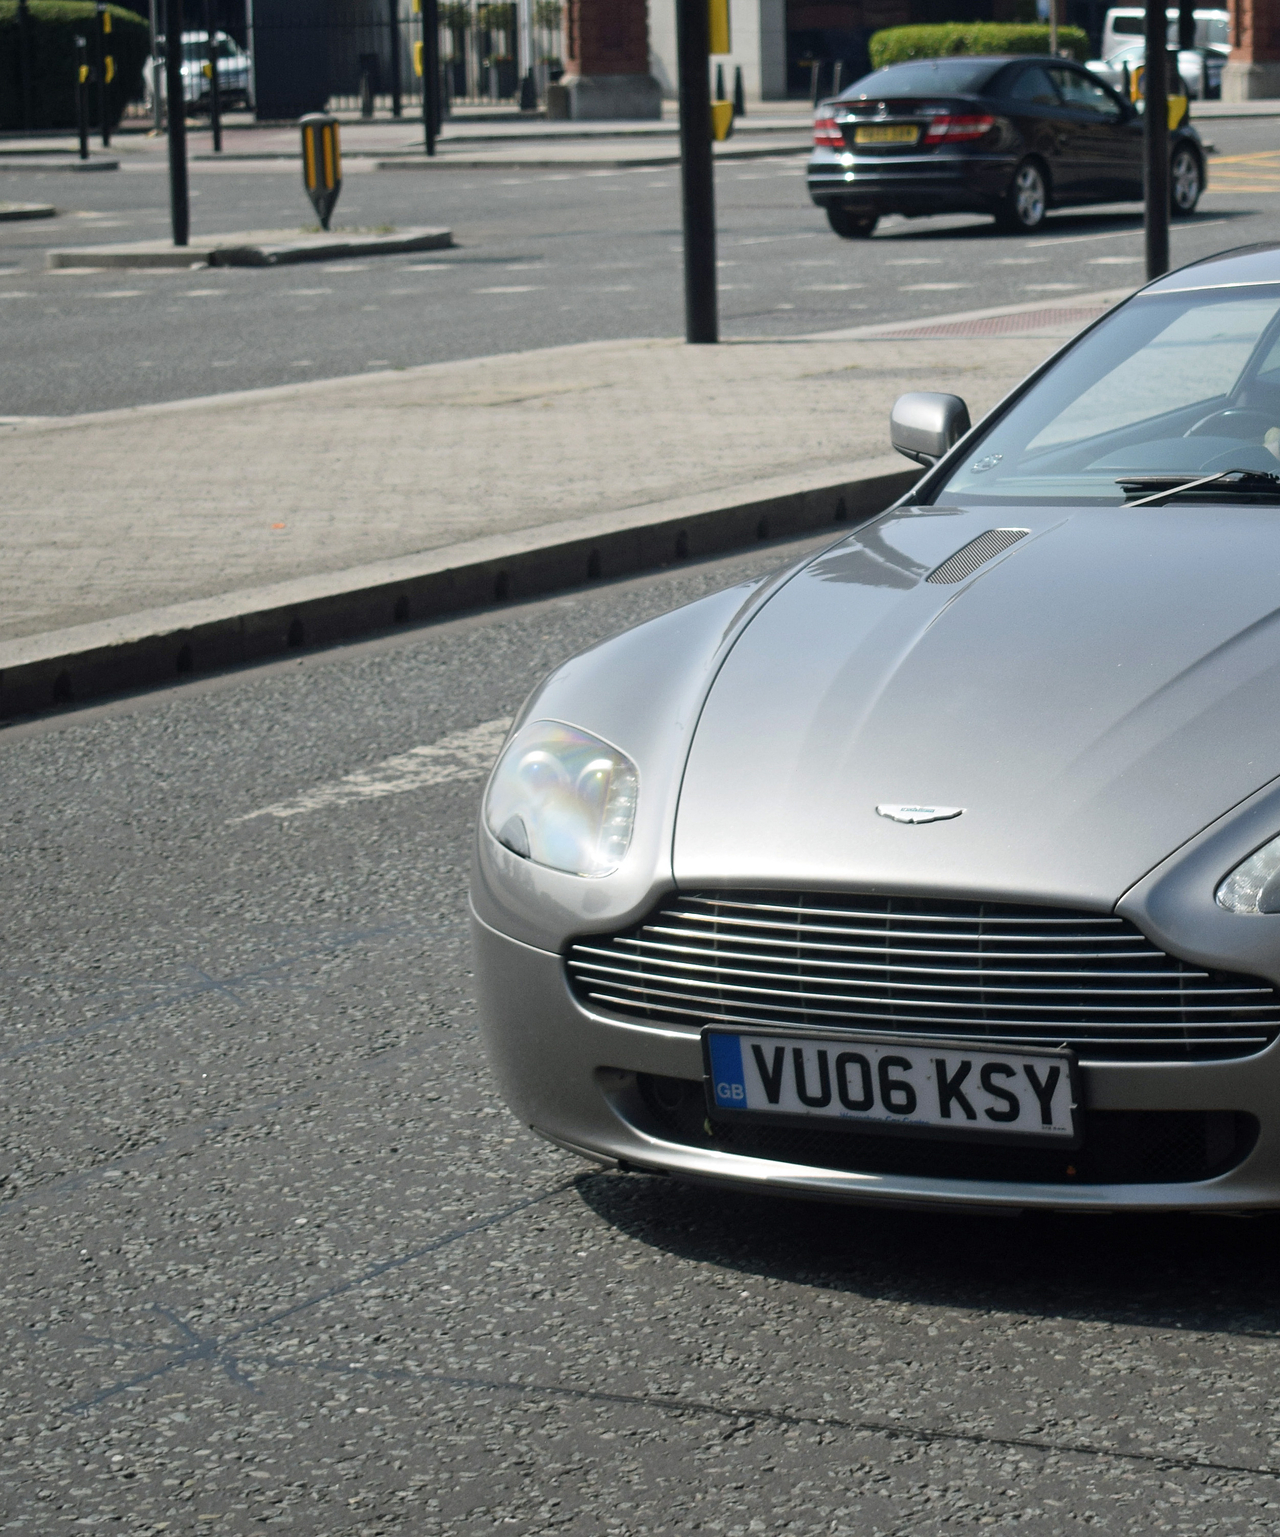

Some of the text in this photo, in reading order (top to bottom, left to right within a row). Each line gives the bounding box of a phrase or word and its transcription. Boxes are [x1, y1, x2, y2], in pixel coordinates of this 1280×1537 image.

[717, 1082, 744, 1100] GB
[750, 1044, 1061, 1126] VU06 KSY
